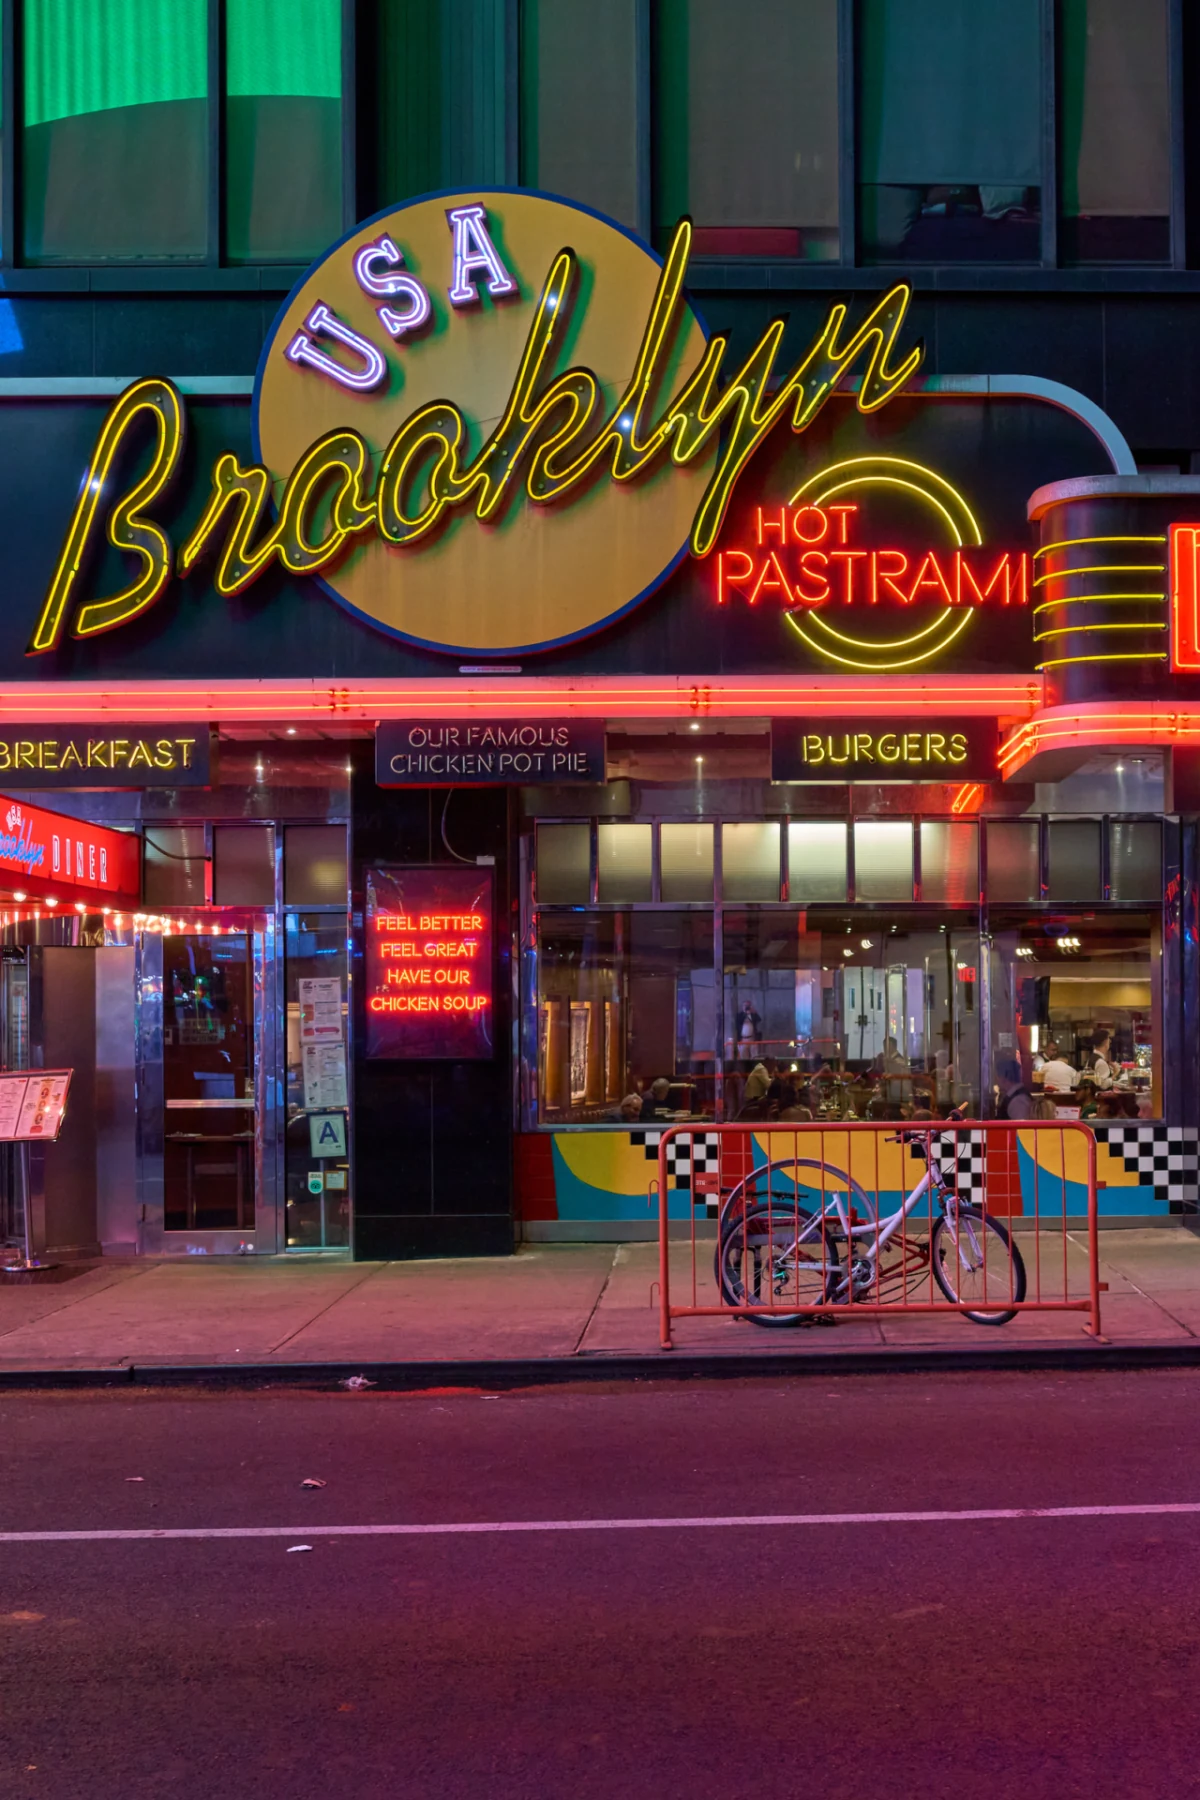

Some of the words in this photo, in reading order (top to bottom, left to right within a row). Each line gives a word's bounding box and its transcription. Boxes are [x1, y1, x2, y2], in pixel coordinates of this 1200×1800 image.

[283, 201, 518, 392] USA
[25, 215, 925, 657] Brooklyn
[757, 505, 858, 545] HOT
[718, 550, 1028, 604] PASTRAMI
[408, 726, 460, 748] OUR
[467, 726, 570, 748] FAMOUS
[802, 733, 968, 763] BURGERS
[390, 754, 493, 775] CHICKEN
[499, 753, 545, 774] POT
[552, 752, 588, 773] PIE
[52, 834, 108, 883] DINER
[376, 916, 417, 931] FEEL
[420, 915, 483, 931] BETTER
[380, 943, 422, 958] FEEL
[424, 942, 477, 957] GREAT
[387, 969, 431, 984] HAVE
[434, 969, 470, 985] OUR
[370, 996, 439, 1011] CHICKEN
[442, 996, 487, 1010] SOUP
[318, 1121, 339, 1144] A
